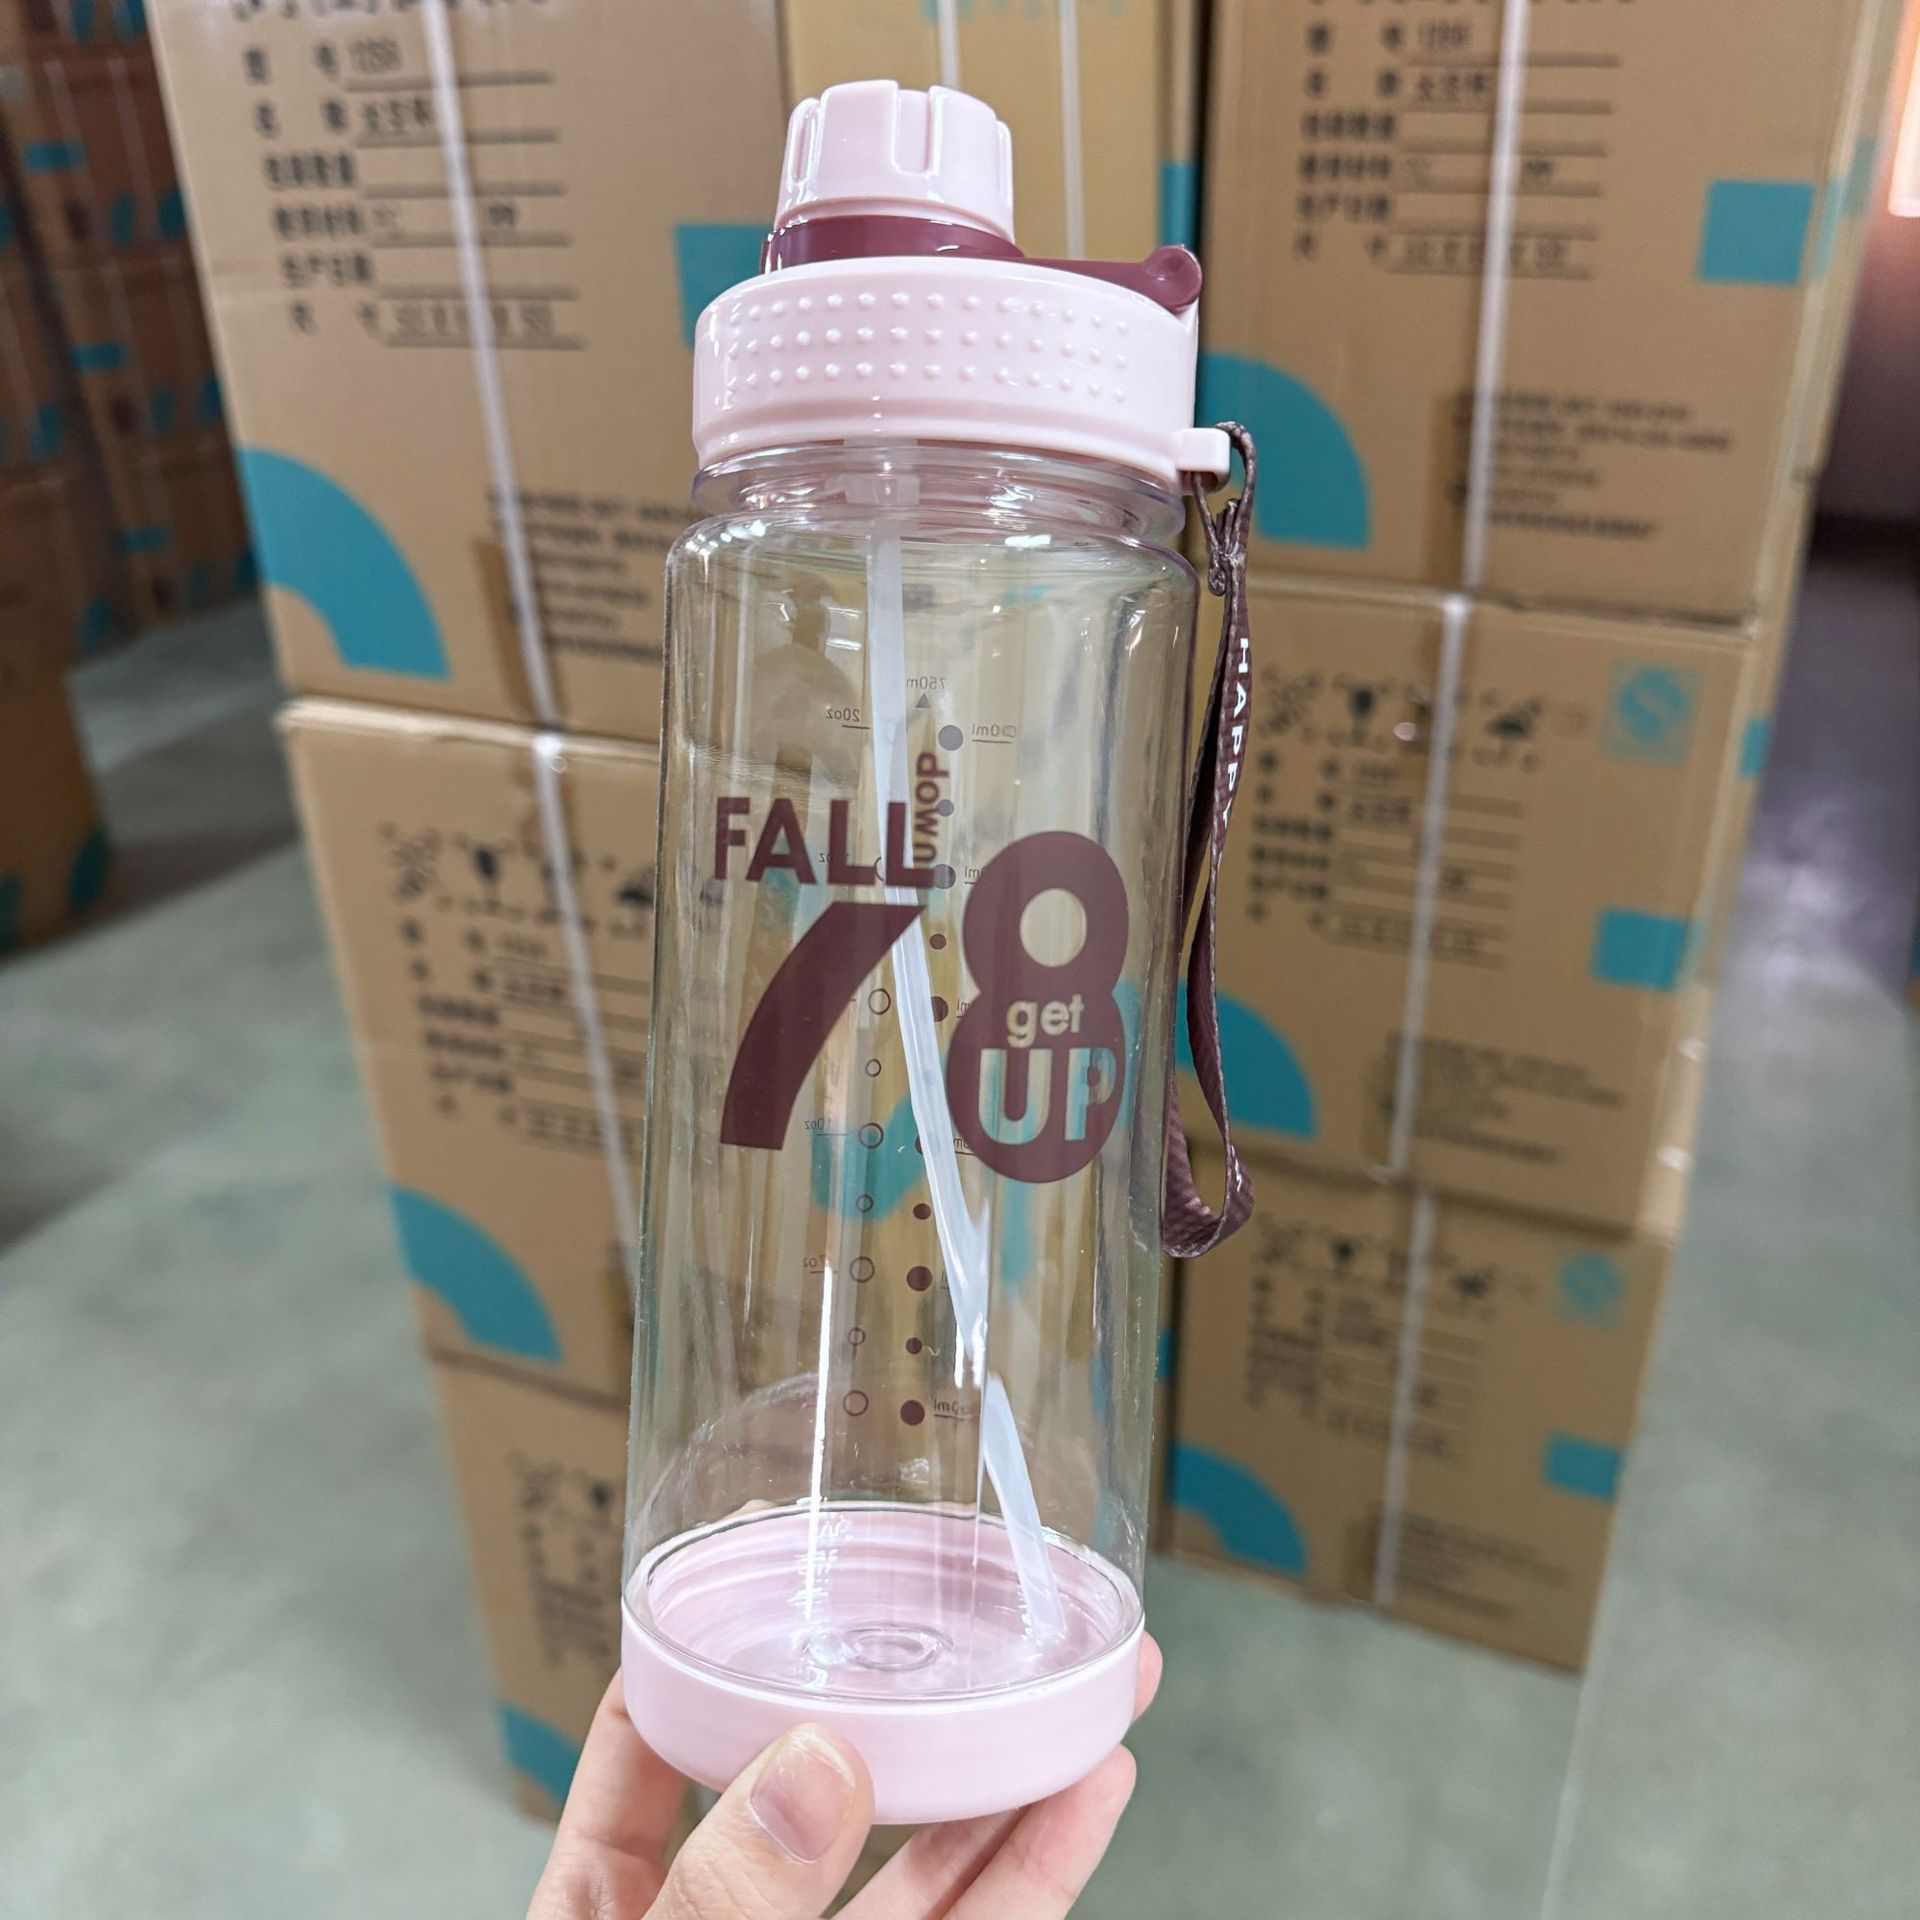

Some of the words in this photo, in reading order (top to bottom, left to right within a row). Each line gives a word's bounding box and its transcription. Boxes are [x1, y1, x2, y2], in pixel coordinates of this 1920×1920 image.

[1221, 637, 1249, 830] HAPPY
[714, 796, 937, 888] FALL
[914, 752, 949, 863] down
[720, 901, 927, 1151] 7
[946, 830, 1129, 1184] 8
[1006, 994, 1086, 1049] get
[978, 1047, 1118, 1146] UP
